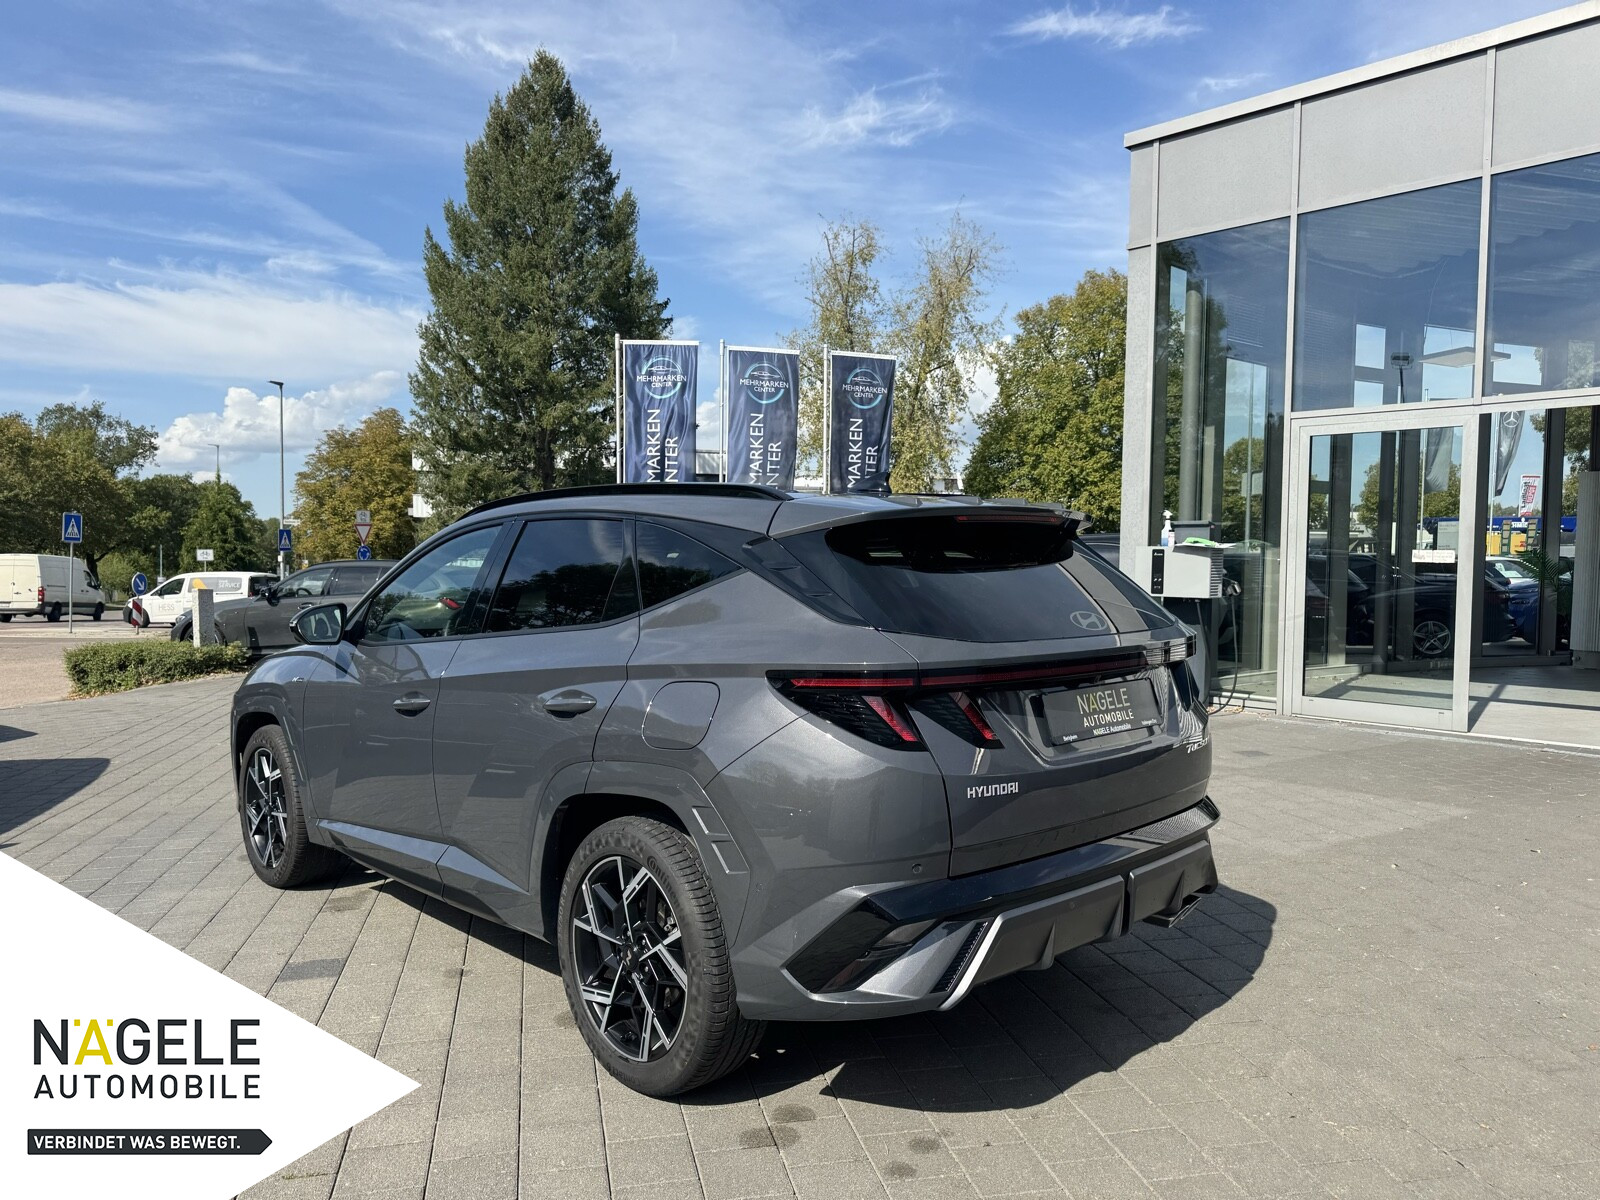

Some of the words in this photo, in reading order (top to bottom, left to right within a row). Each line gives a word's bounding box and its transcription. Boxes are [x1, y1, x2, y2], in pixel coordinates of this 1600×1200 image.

[637, 374, 687, 383] MEHRMARKEN
[739, 378, 789, 389] MEHRMARKEN
[842, 383, 888, 394] MEHRMARKEN
[853, 391, 875, 399] CENTER
[647, 409, 660, 482] MARKEN
[865, 445, 879, 479] TER
[158, 603, 174, 611] HESS
[1076, 688, 1131, 714] NÄGELE
[1083, 709, 1135, 728] AUTOMOBILE
[967, 781, 1019, 799] HYUNDAI
